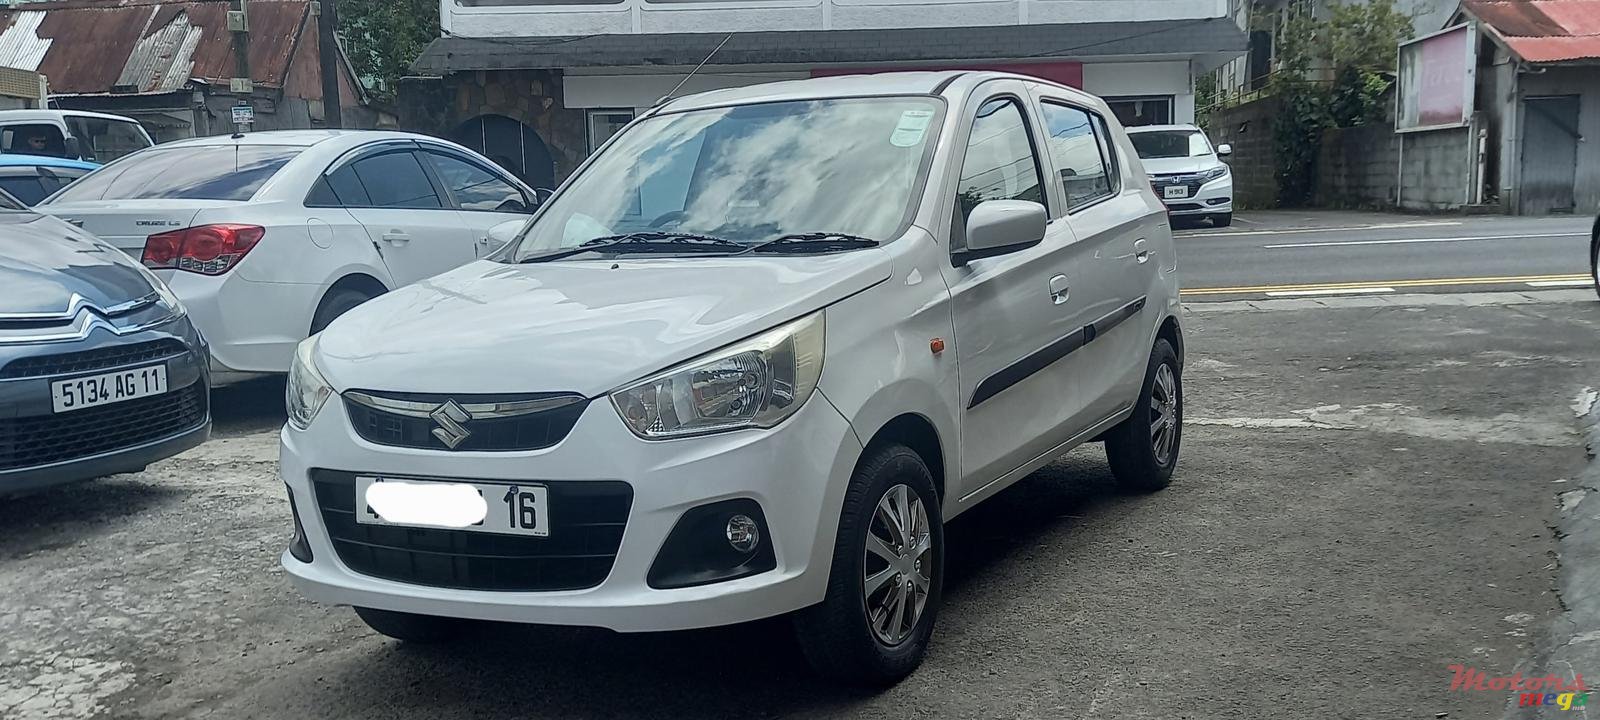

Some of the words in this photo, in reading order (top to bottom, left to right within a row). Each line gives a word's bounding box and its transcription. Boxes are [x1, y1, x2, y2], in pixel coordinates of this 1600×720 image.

[62, 378, 110, 408] 5134
[115, 373, 136, 399] AG
[141, 368, 159, 393] 11
[503, 490, 537, 530] 16
